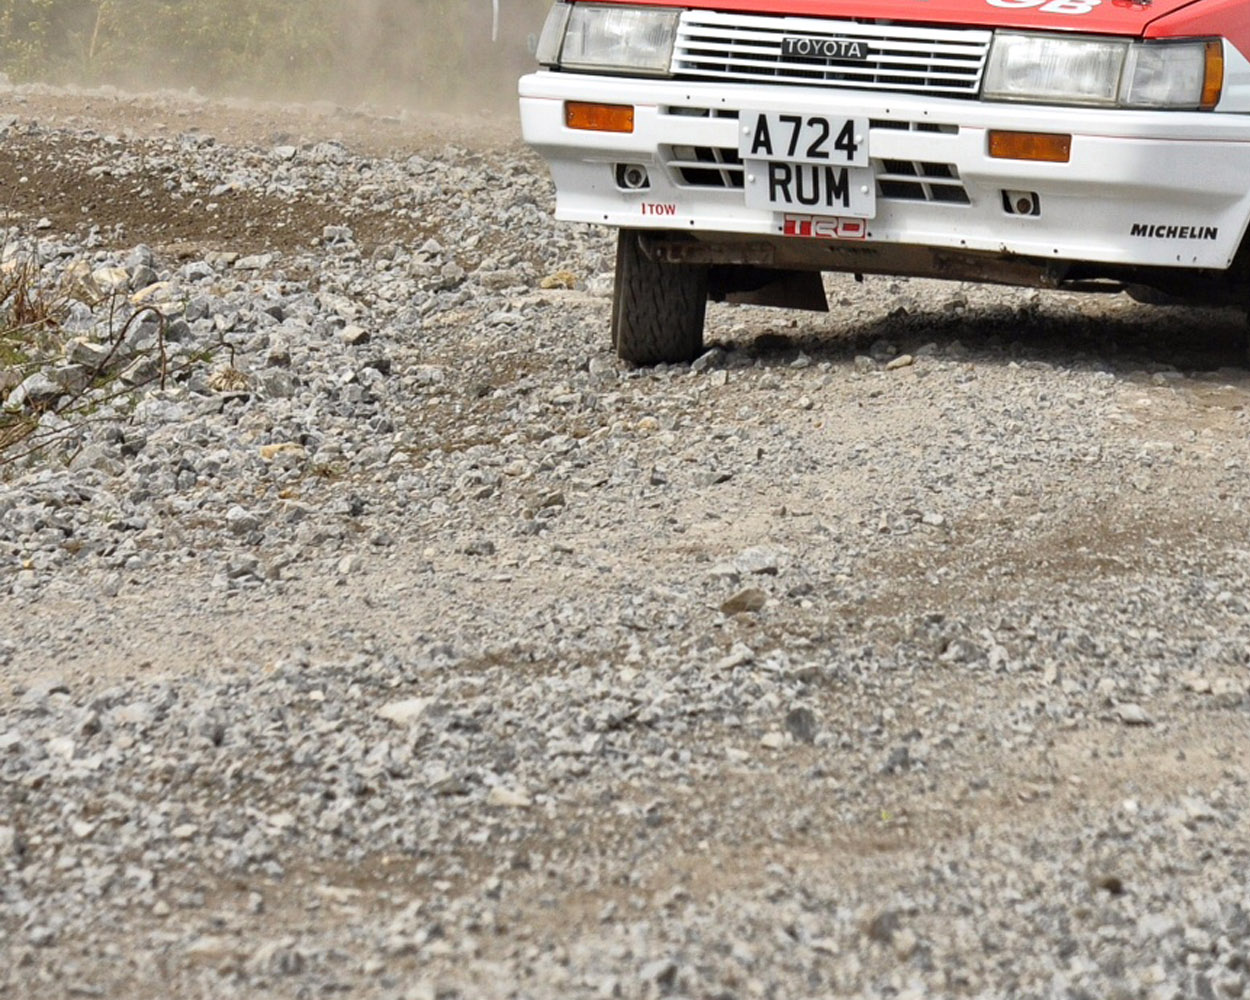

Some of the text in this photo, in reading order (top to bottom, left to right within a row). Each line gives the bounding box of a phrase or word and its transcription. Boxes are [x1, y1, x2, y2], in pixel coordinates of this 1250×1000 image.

[785, 38, 861, 58] TOYOTA
[751, 113, 858, 161] A724
[768, 161, 850, 208] RUM
[648, 203, 676, 216] TOW
[783, 214, 867, 240] TRD
[1130, 223, 1219, 241] MICHELIN
